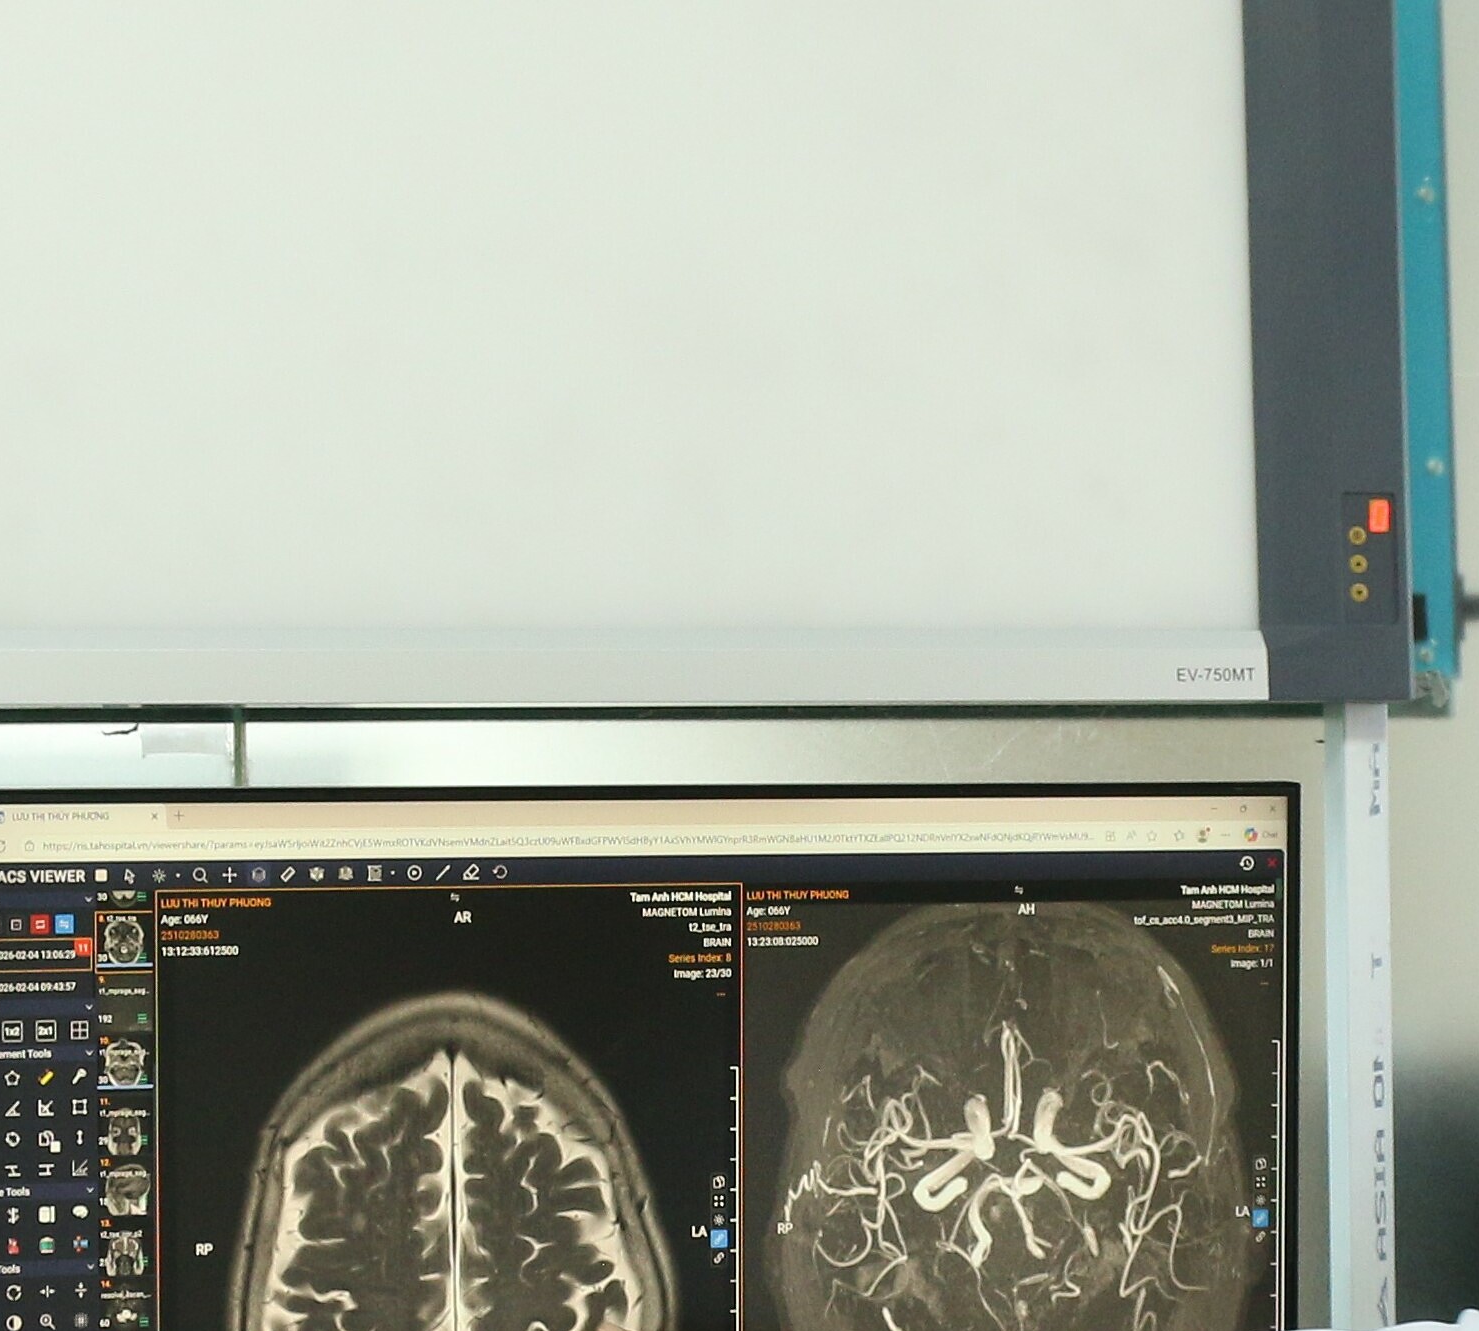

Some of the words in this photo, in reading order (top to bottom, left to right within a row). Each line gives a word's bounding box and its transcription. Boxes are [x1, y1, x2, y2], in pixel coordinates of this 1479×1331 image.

[1177, 667, 1255, 682] EV-750MT
[29, 869, 86, 883] VIEWER
[766, 890, 781, 900] THI
[783, 890, 809, 900] THUY
[810, 889, 850, 900] PHUONG
[1180, 885, 1200, 895] Tam
[1201, 885, 1218, 895] Anh
[1219, 884, 1239, 895] HCM
[1241, 884, 1275, 896] Hospital
[630, 892, 650, 902] Tam
[652, 891, 669, 902] Anh
[671, 891, 693, 902] HCM
[695, 890, 732, 903] Hospital
[182, 898, 198, 908] THI
[201, 898, 227, 908] THUY
[229, 897, 272, 908] PHUONG
[1191, 900, 1243, 910] MAGNETOM
[1245, 899, 1275, 909] Lumina
[642, 907, 697, 917] MAGNETOM
[699, 906, 732, 917] Lumina
[746, 906, 766, 918] Age:
[768, 905, 791, 916] 066Y
[1018, 903, 1035, 916] AH
[161, 914, 182, 927] Age:
[184, 913, 209, 925] 066Y
[454, 910, 472, 924] AR
[1248, 929, 1274, 939] BRAIN
[703, 937, 732, 947] BRAIN
[1211, 944, 1236, 954] Series
[668, 953, 696, 963] Series
[674, 969, 704, 980] Image:
[705, 968, 732, 978] 23/30
[98, 1014, 113, 1024] 192
[28, 1049, 52, 1059] Tools
[6, 1186, 30, 1197] Tools
[1235, 1205, 1251, 1218] LA
[691, 1225, 708, 1238] LA
[777, 1223, 794, 1234] RP
[195, 1243, 213, 1256] RP
